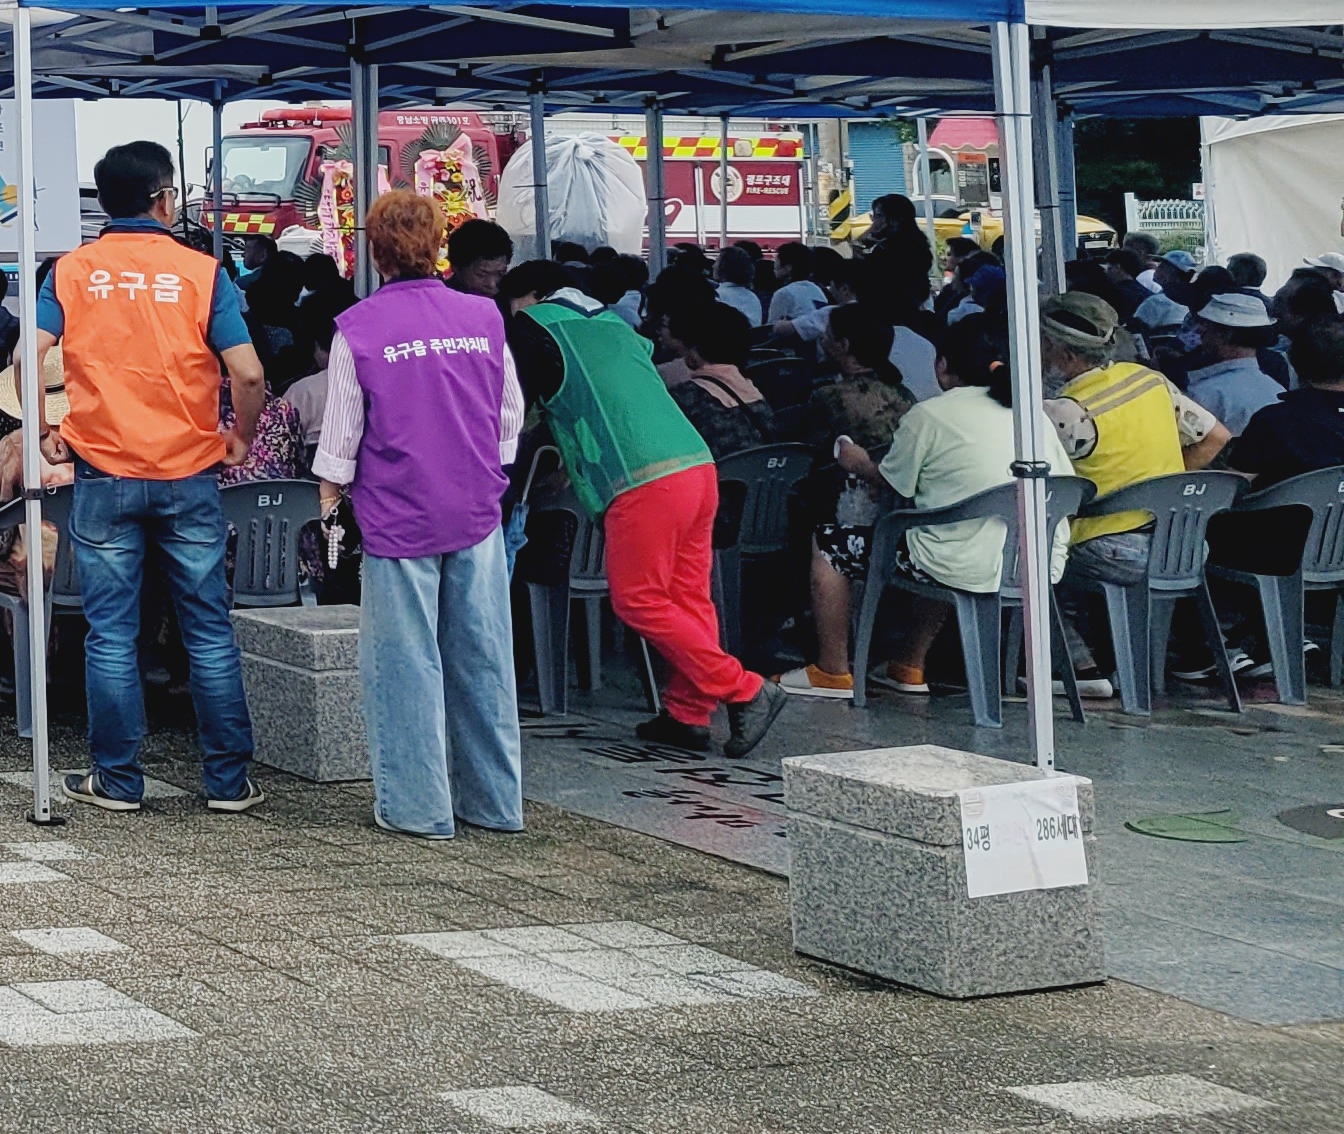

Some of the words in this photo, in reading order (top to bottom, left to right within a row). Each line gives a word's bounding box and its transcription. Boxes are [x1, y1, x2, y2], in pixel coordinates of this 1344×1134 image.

[87, 269, 183, 303] 유구읍
[383, 339, 427, 363] 유구읍
[429, 336, 491, 355] 주민자치회
[767, 457, 788, 469] BJ
[257, 493, 283, 507] BJ
[1182, 483, 1207, 497] BJ
[966, 823, 991, 852] 34평
[1036, 812, 1080, 841] 286세대
